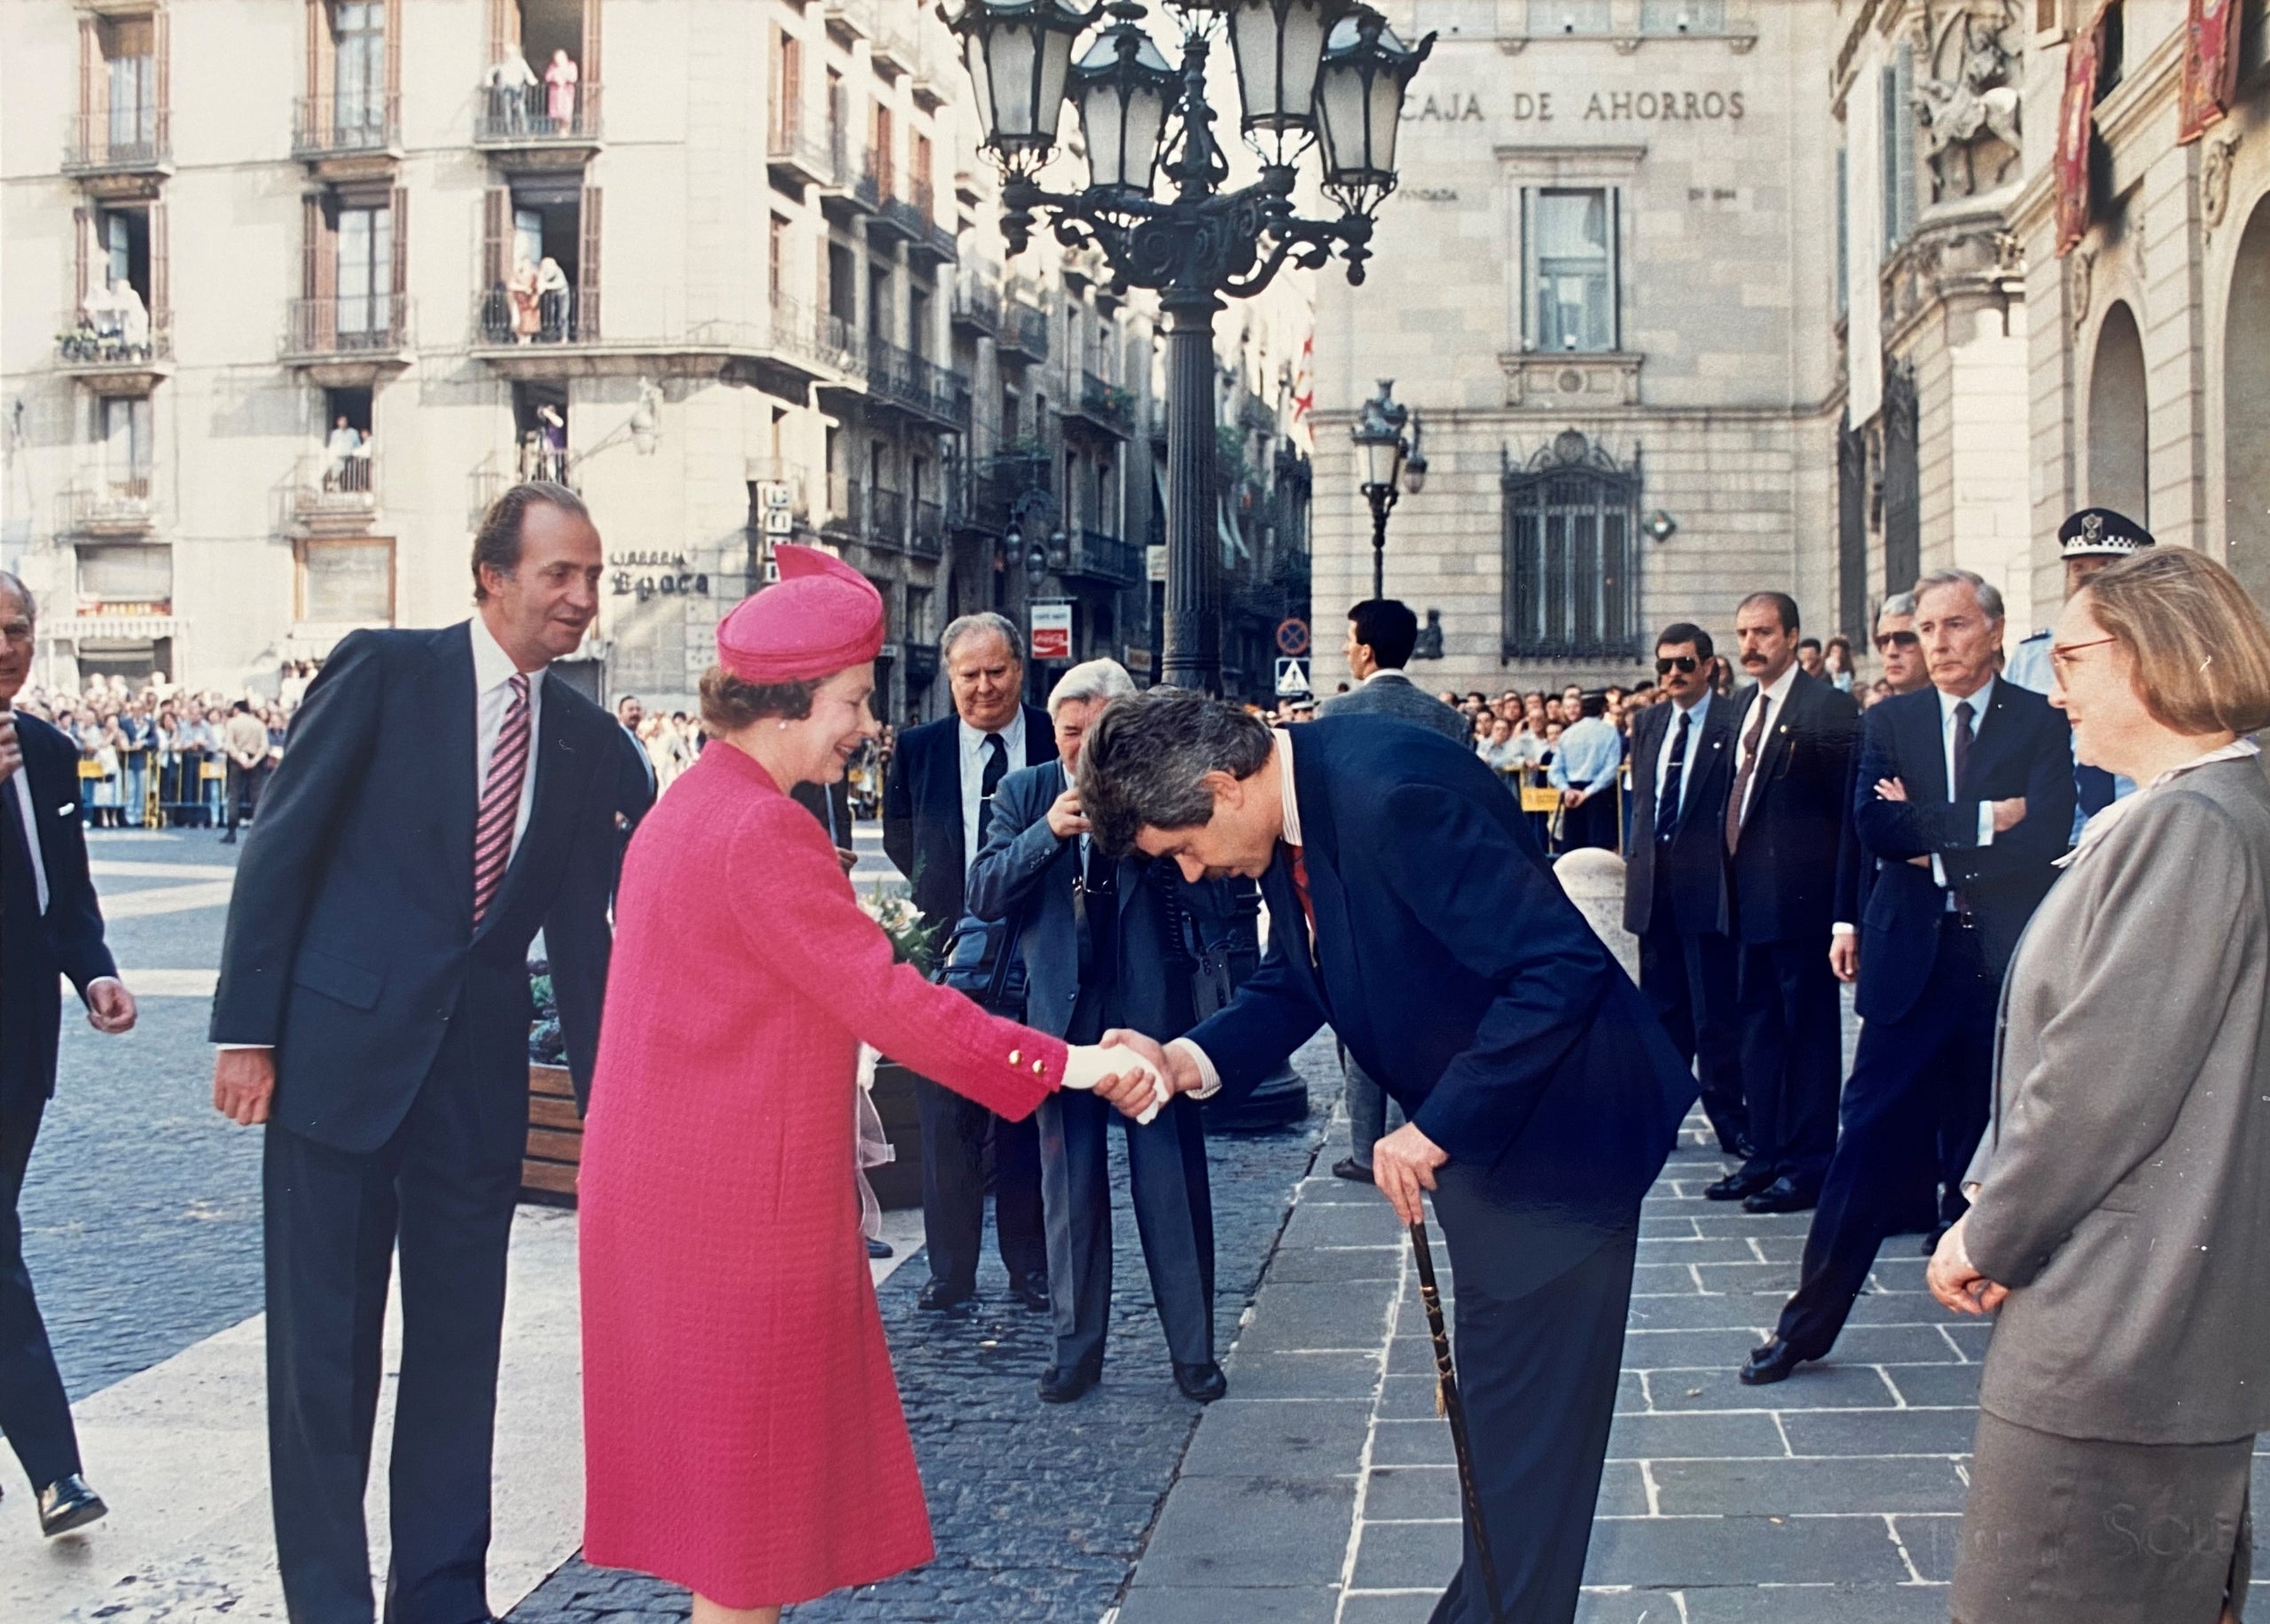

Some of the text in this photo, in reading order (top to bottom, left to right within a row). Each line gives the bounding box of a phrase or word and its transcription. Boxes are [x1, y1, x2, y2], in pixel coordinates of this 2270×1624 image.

[1400, 92, 1745, 121] CAJA DE AHORROS
